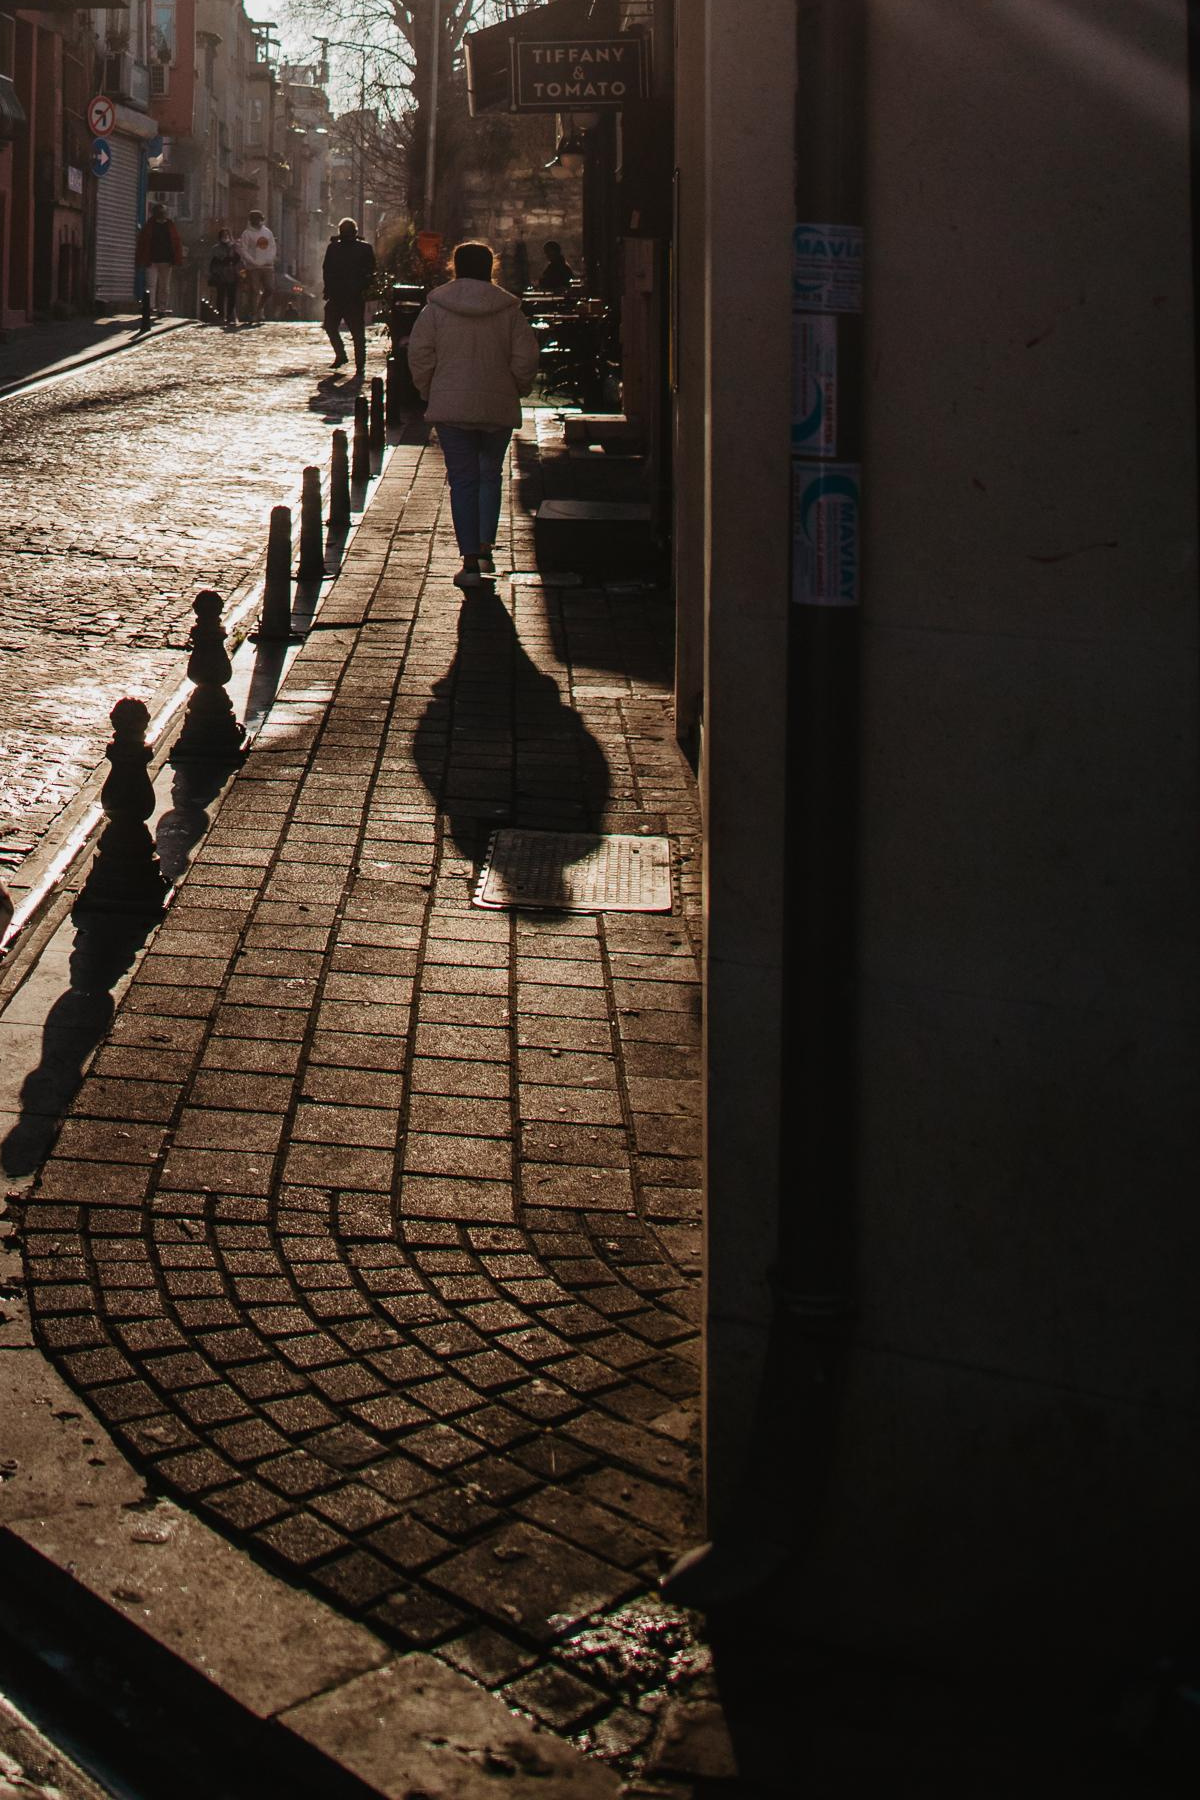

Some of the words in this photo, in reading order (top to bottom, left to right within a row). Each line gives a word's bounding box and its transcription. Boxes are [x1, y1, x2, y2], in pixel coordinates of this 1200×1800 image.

[532, 48, 624, 63] TIFFANY
[572, 65, 585, 80] &
[533, 81, 625, 97] TOMATO
